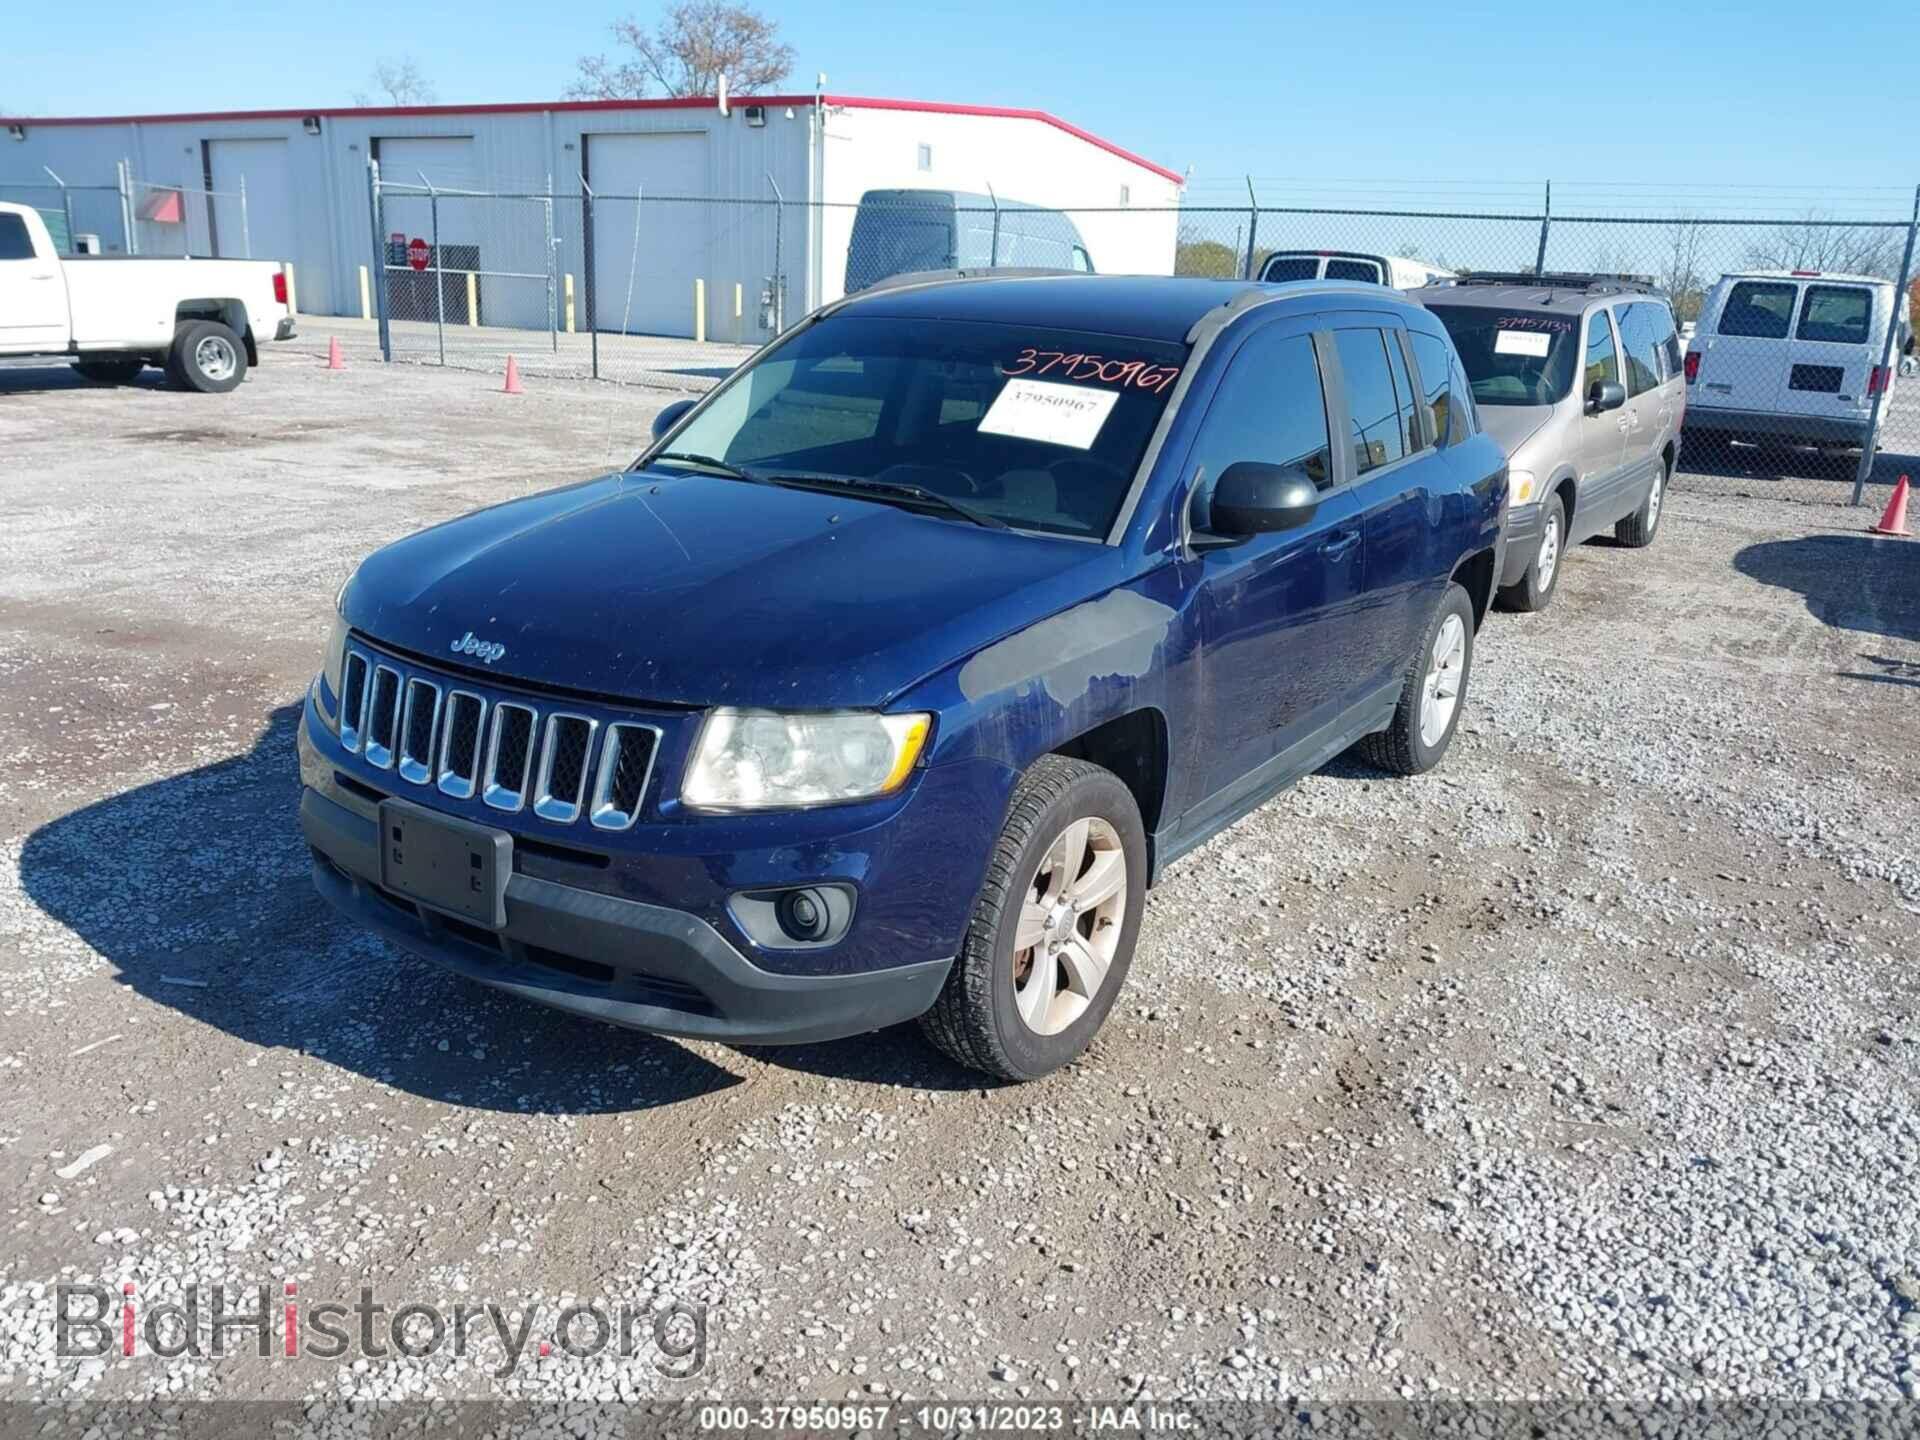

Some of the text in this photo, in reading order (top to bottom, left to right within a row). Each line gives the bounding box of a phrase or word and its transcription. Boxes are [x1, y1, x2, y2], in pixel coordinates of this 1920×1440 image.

[408, 247, 429, 261] STOP
[1001, 348, 1179, 394] 37950967
[450, 631, 505, 665] Jeep
